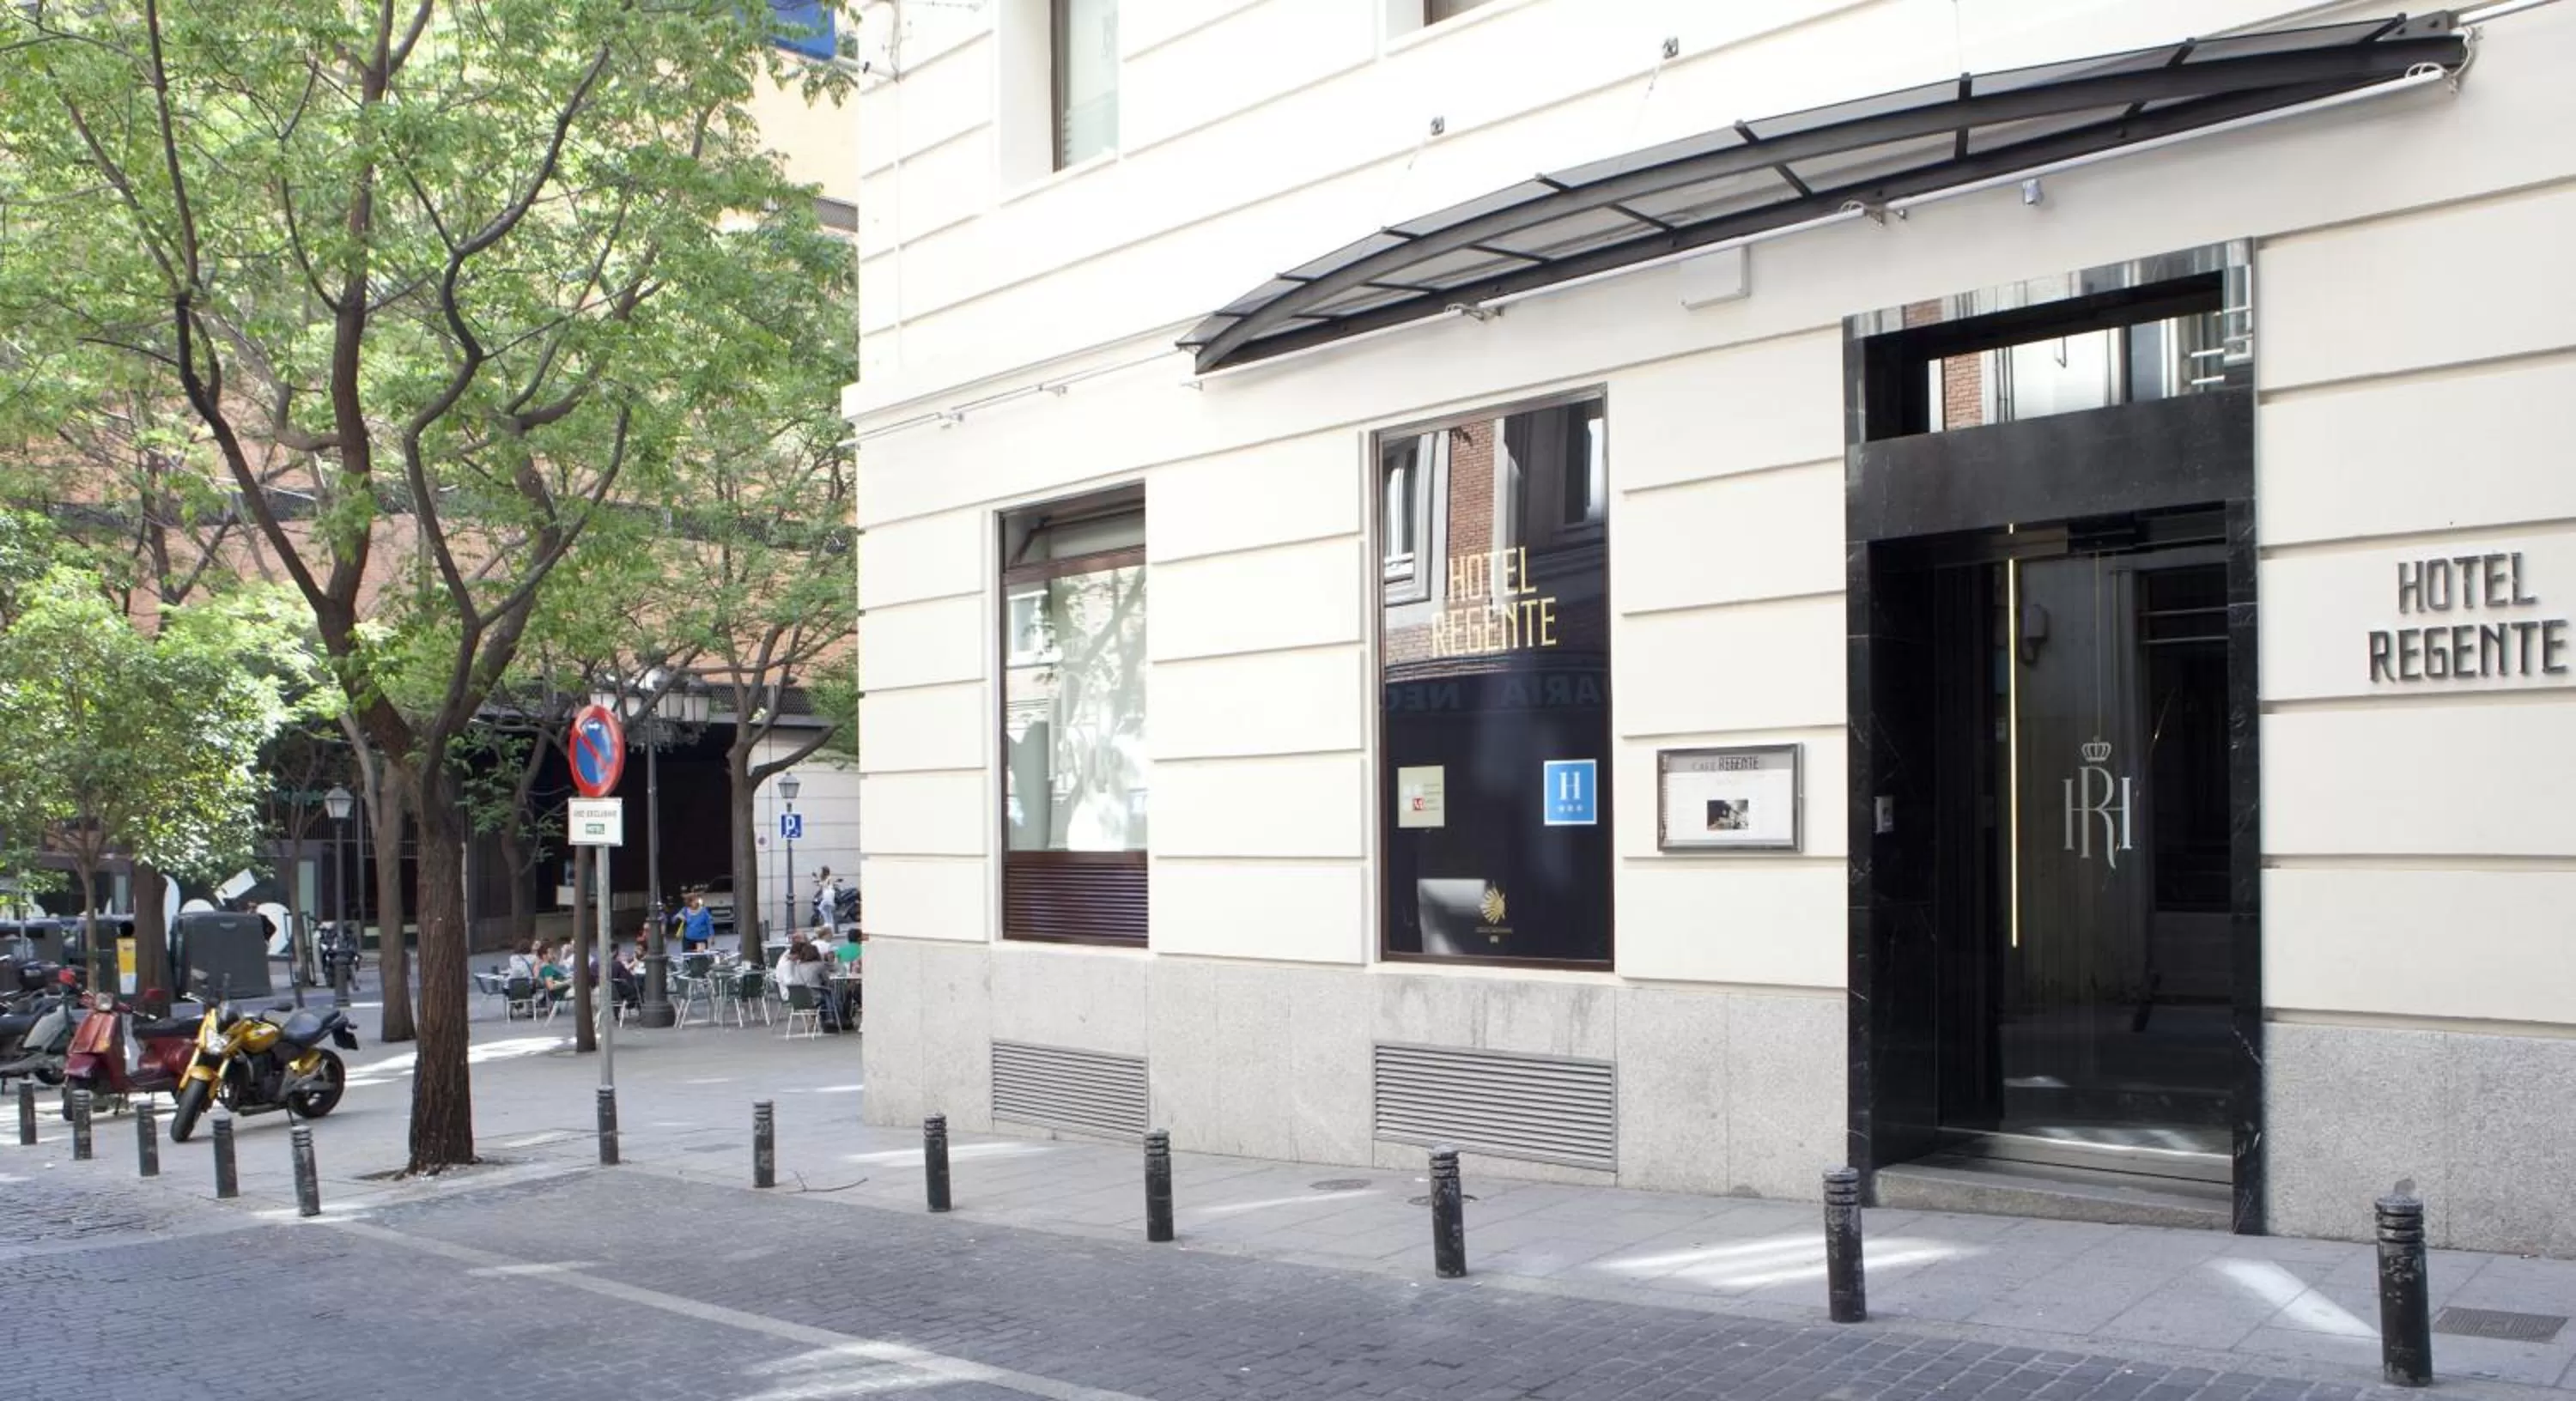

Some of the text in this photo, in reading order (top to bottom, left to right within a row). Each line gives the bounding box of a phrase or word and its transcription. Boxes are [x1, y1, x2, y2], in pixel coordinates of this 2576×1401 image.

[1449, 547, 1537, 602] HOTEL
[2397, 552, 2539, 614] HOTEL
[1431, 597, 1557, 658] REGENTE
[2368, 619, 2568, 683] REGENTE
[1558, 771, 1581, 800] H
[1718, 755, 1759, 771] REGENTE
[786, 816, 796, 834] P
